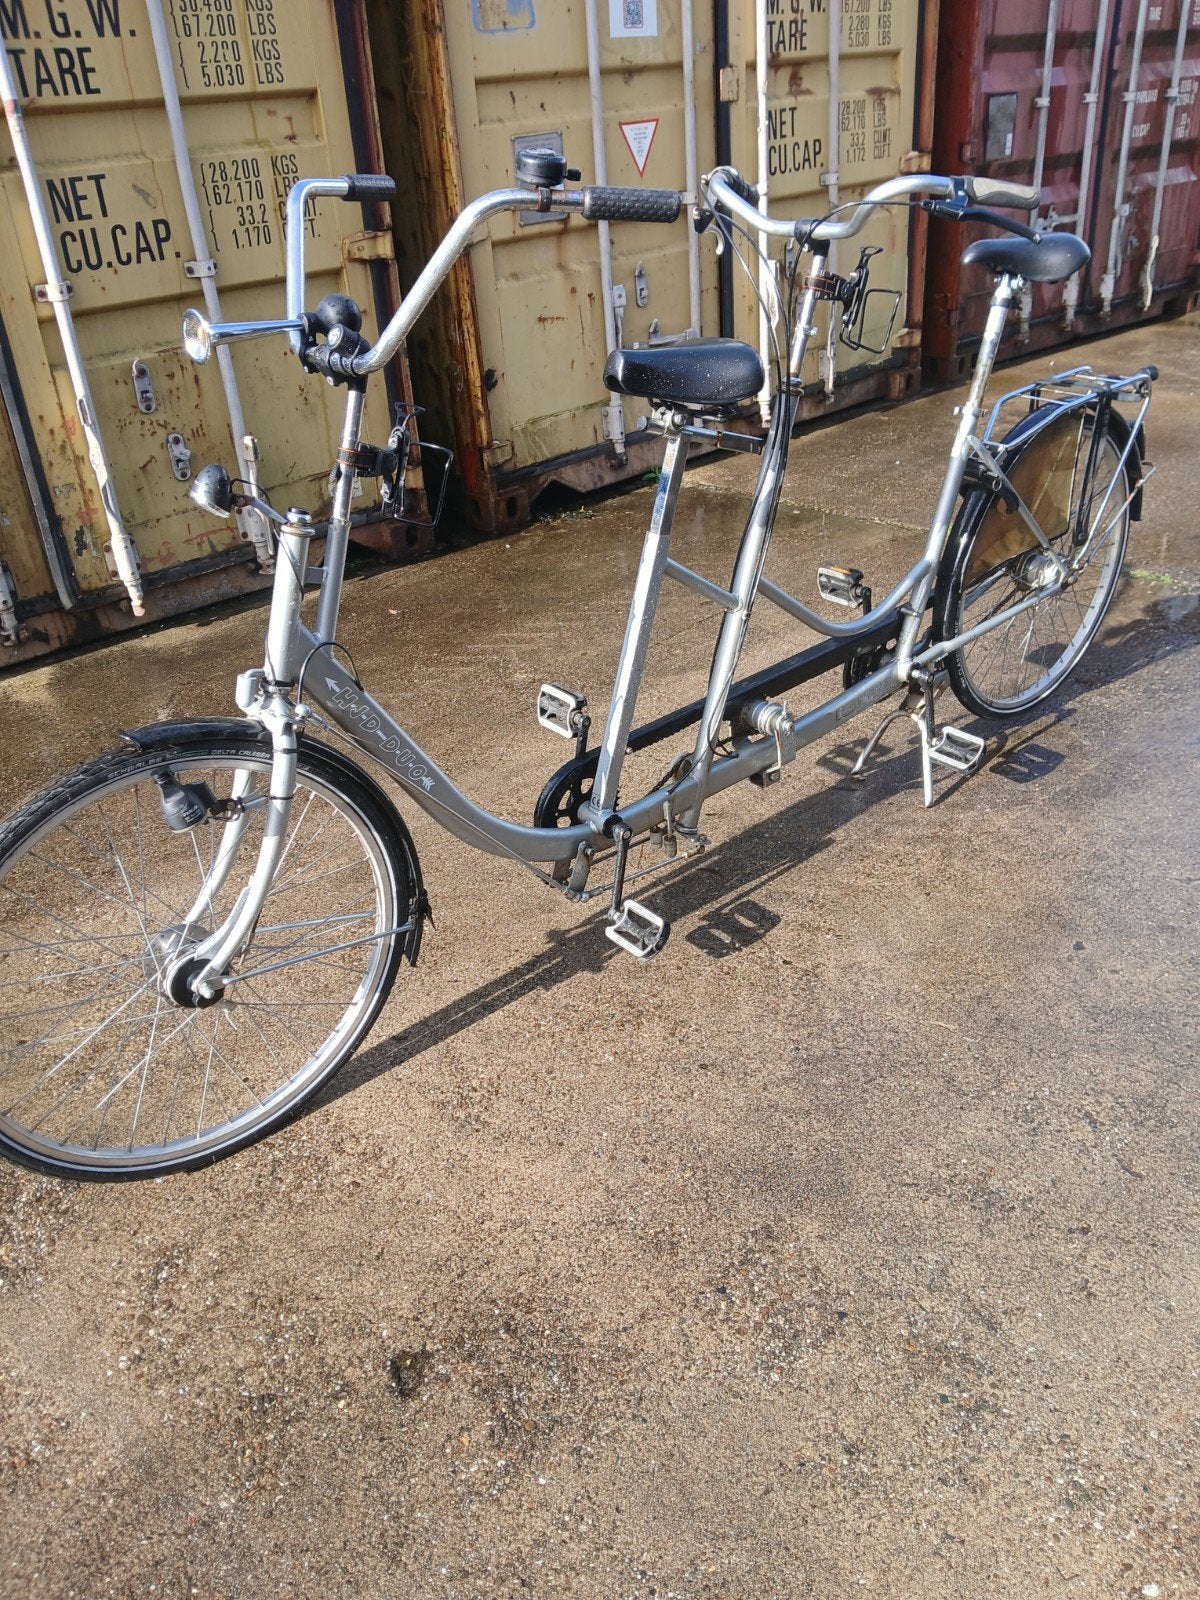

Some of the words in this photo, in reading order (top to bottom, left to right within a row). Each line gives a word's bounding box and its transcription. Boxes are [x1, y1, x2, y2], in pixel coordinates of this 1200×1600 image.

[248, 13, 277, 36] LBS
[767, 19, 807, 54] TARE
[878, 30, 891, 46] LBS
[252, 39, 281, 62] KGS
[6, 47, 101, 98] TARE
[256, 62, 284, 85] LBS
[767, 107, 797, 141] NET
[873, 113, 886, 129] LBS
[271, 153, 299, 176] KGS
[46, 173, 109, 224] NET
[237, 203, 268, 227] 33.2
[59, 218, 182, 274] CU.CAP.
[211, 748, 237, 756] DELTA
[238, 749, 271, 759] CRUISER
